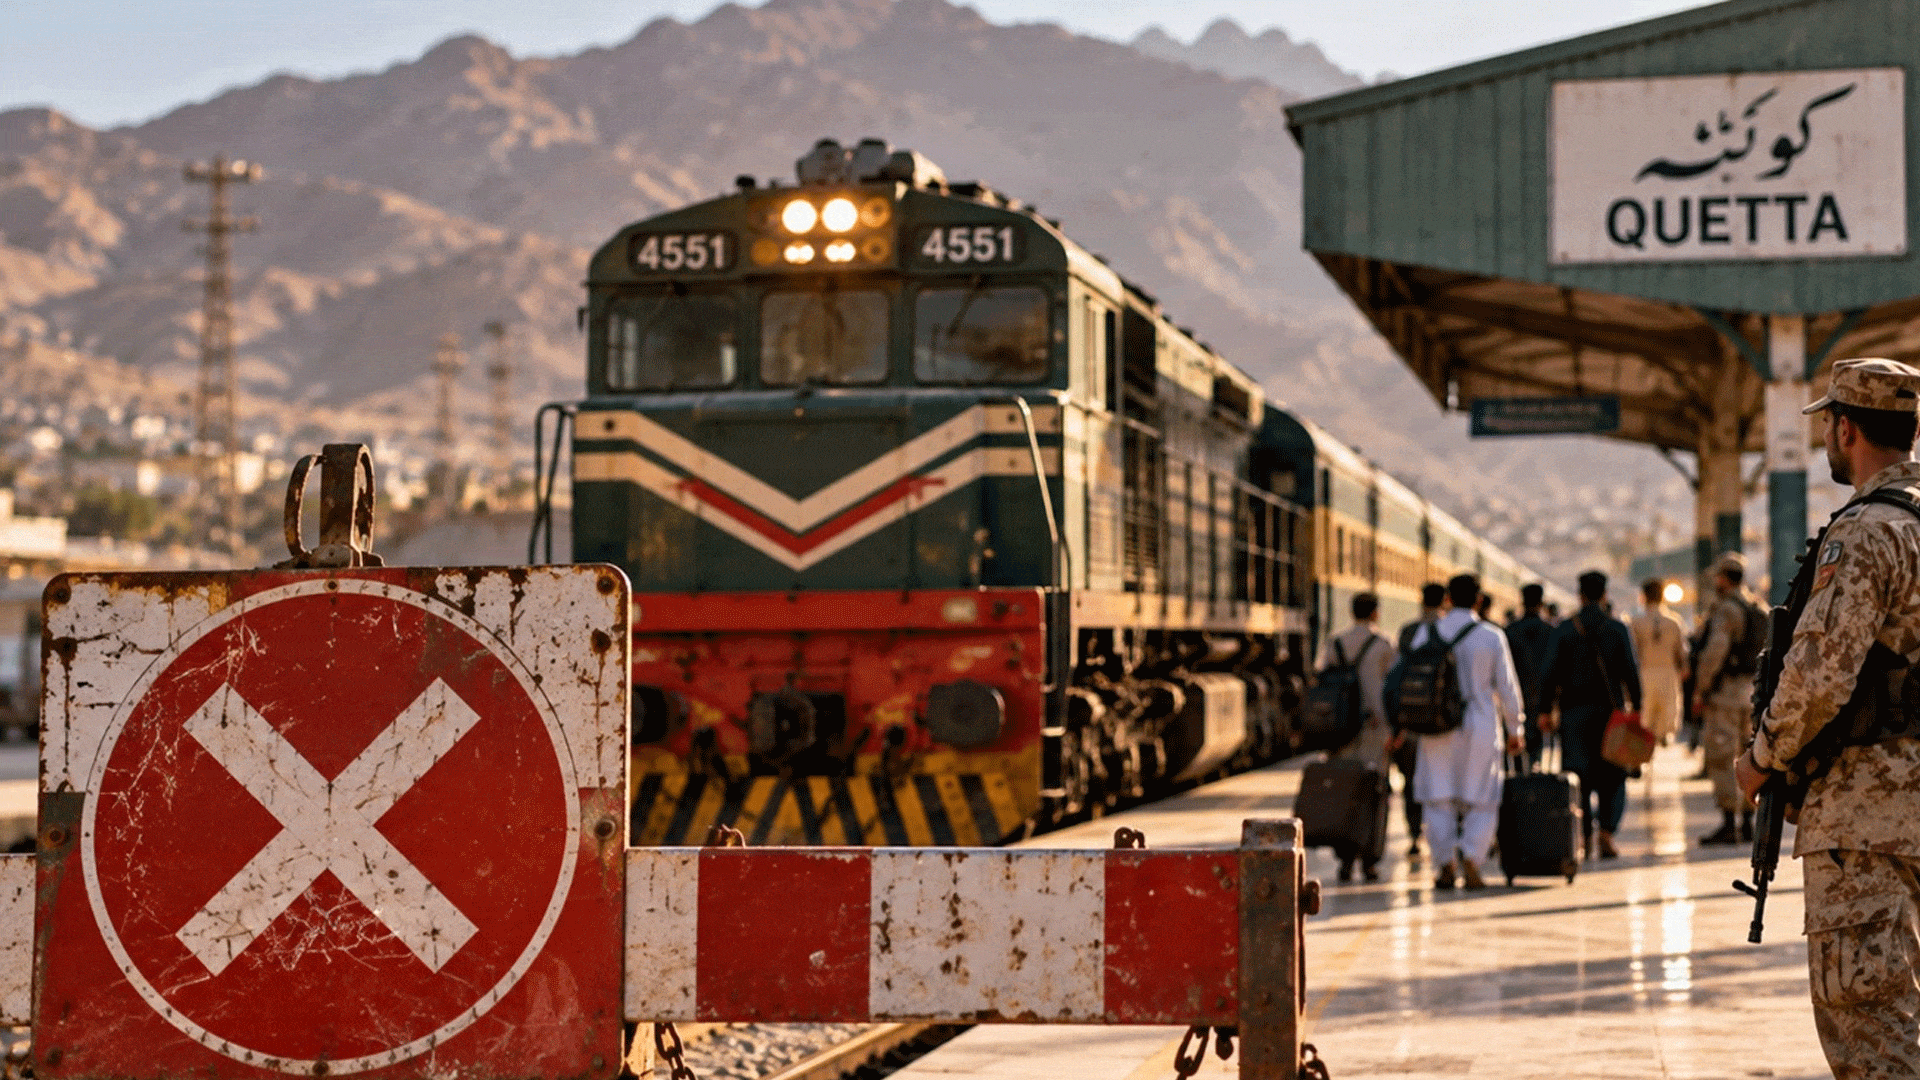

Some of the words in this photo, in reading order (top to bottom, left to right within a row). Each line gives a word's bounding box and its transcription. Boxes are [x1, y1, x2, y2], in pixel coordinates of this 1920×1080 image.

[1605, 192, 1848, 248] QUETTA
[637, 234, 726, 270] 4551
[921, 226, 1014, 263] 4551
